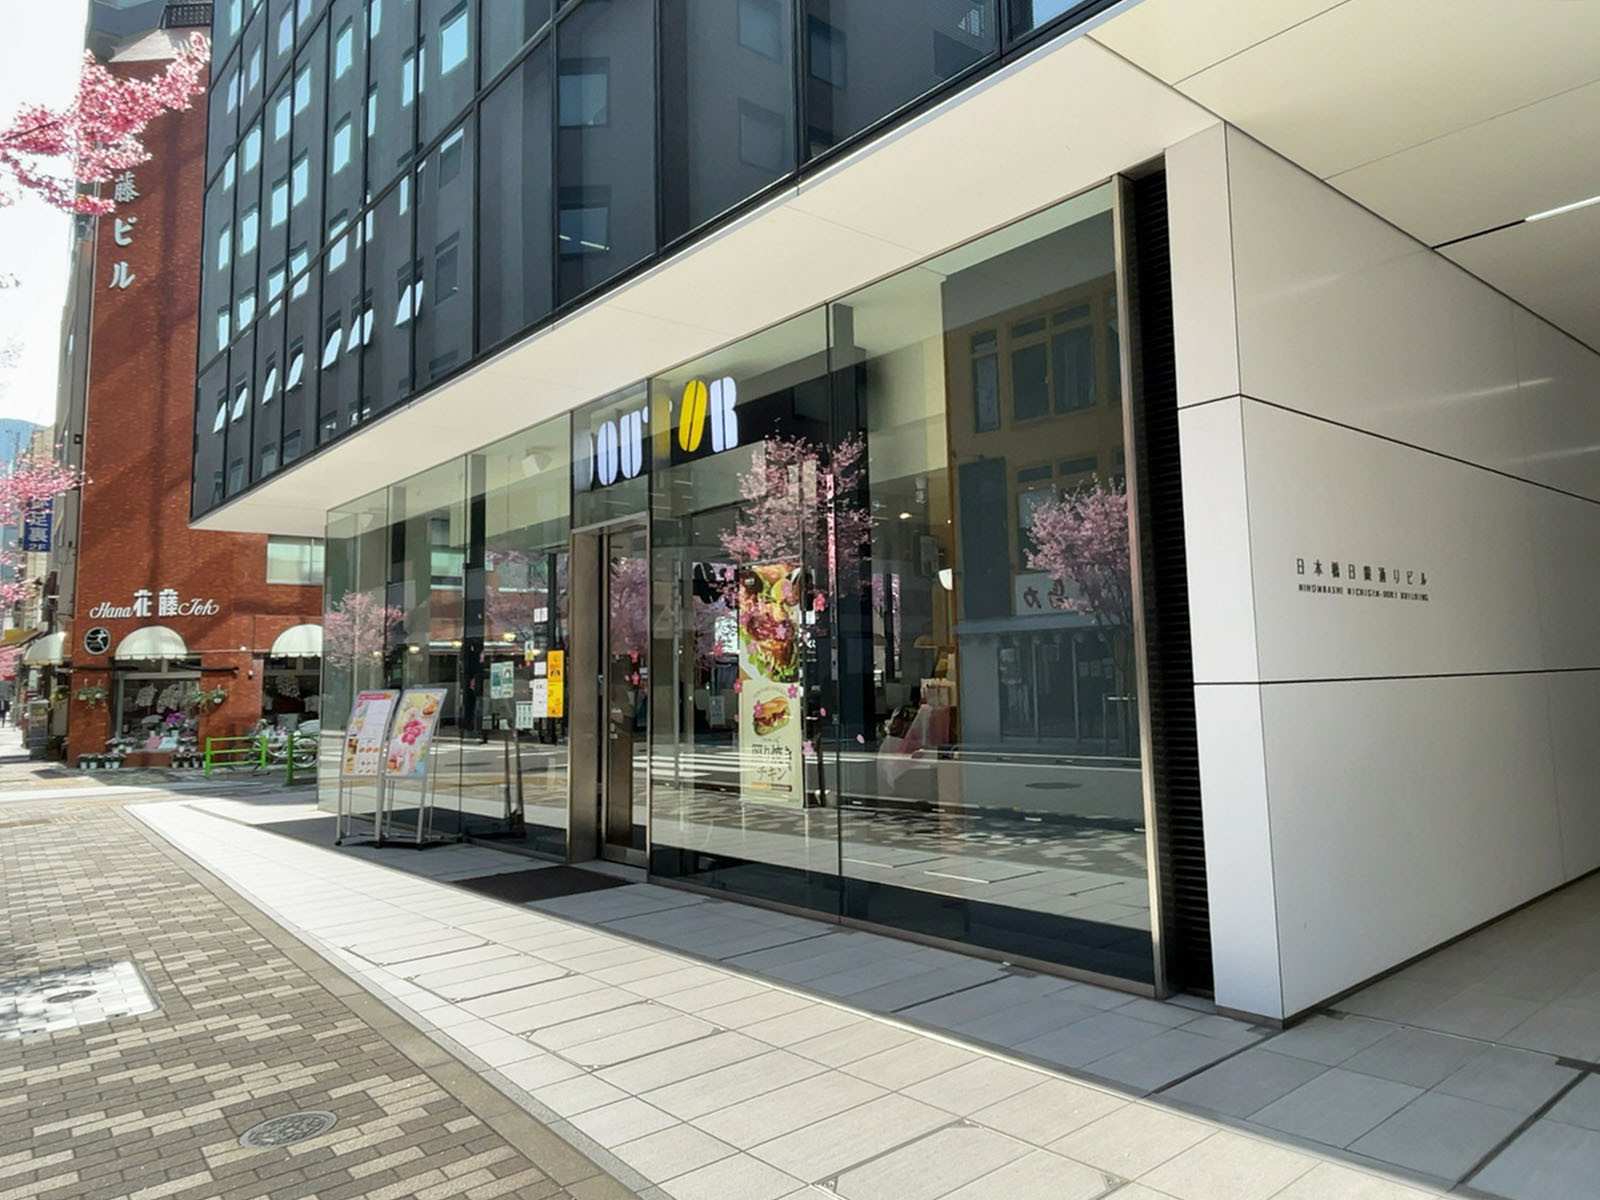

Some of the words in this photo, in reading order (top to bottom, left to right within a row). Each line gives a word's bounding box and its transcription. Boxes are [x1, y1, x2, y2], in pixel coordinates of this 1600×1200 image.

[109, 171, 141, 290] 藤ビル
[89, 602, 133, 619] Hana
[133, 588, 179, 618] 花藤
